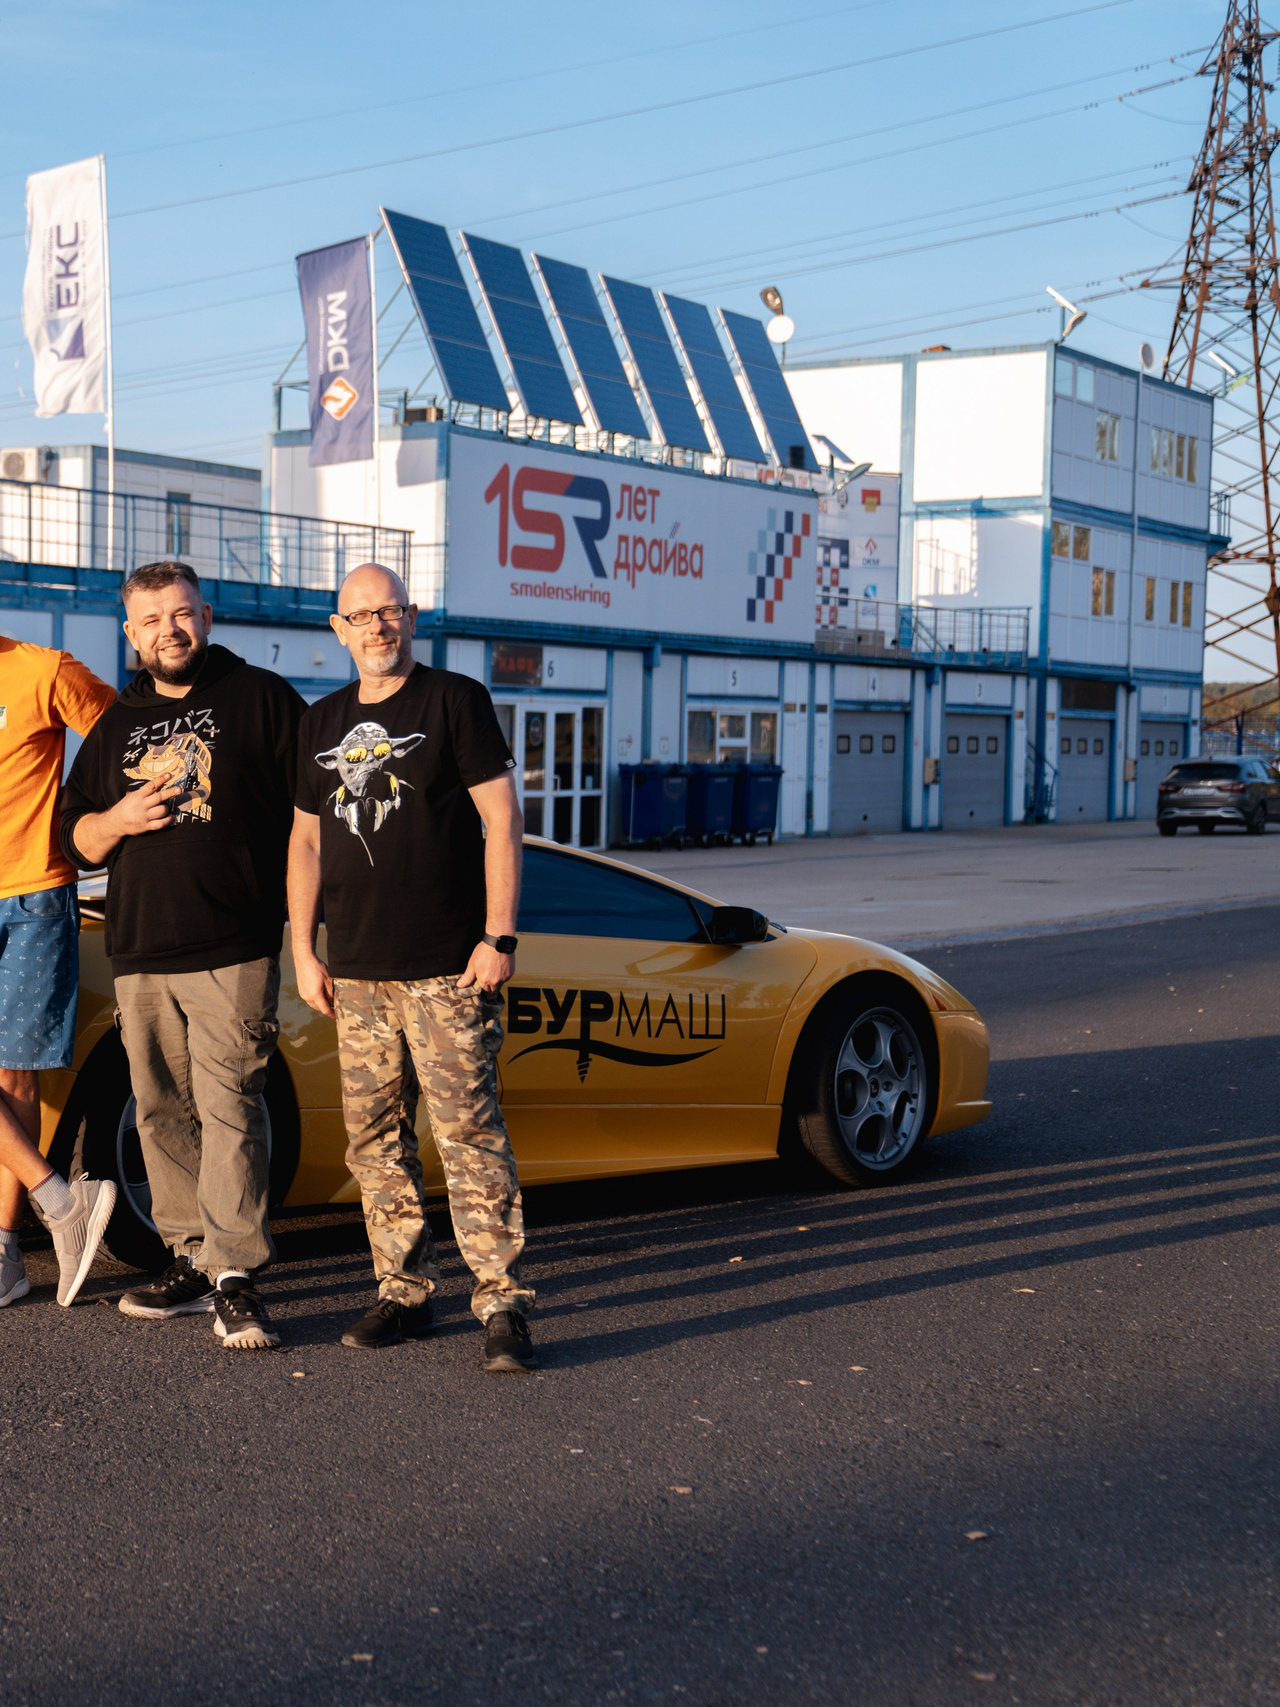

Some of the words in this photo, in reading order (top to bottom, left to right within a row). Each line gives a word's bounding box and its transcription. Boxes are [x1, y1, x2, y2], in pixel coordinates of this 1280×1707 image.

[616, 483, 661, 525] лет
[614, 521, 704, 590] драйва
[509, 581, 611, 609] smolenskring
[271, 643, 280, 665] 7
[547, 660, 554, 678] 6
[731, 670, 737, 687] 5
[127, 708, 214, 746] ネコバス
[507, 987, 726, 1050] БУРМАШ
